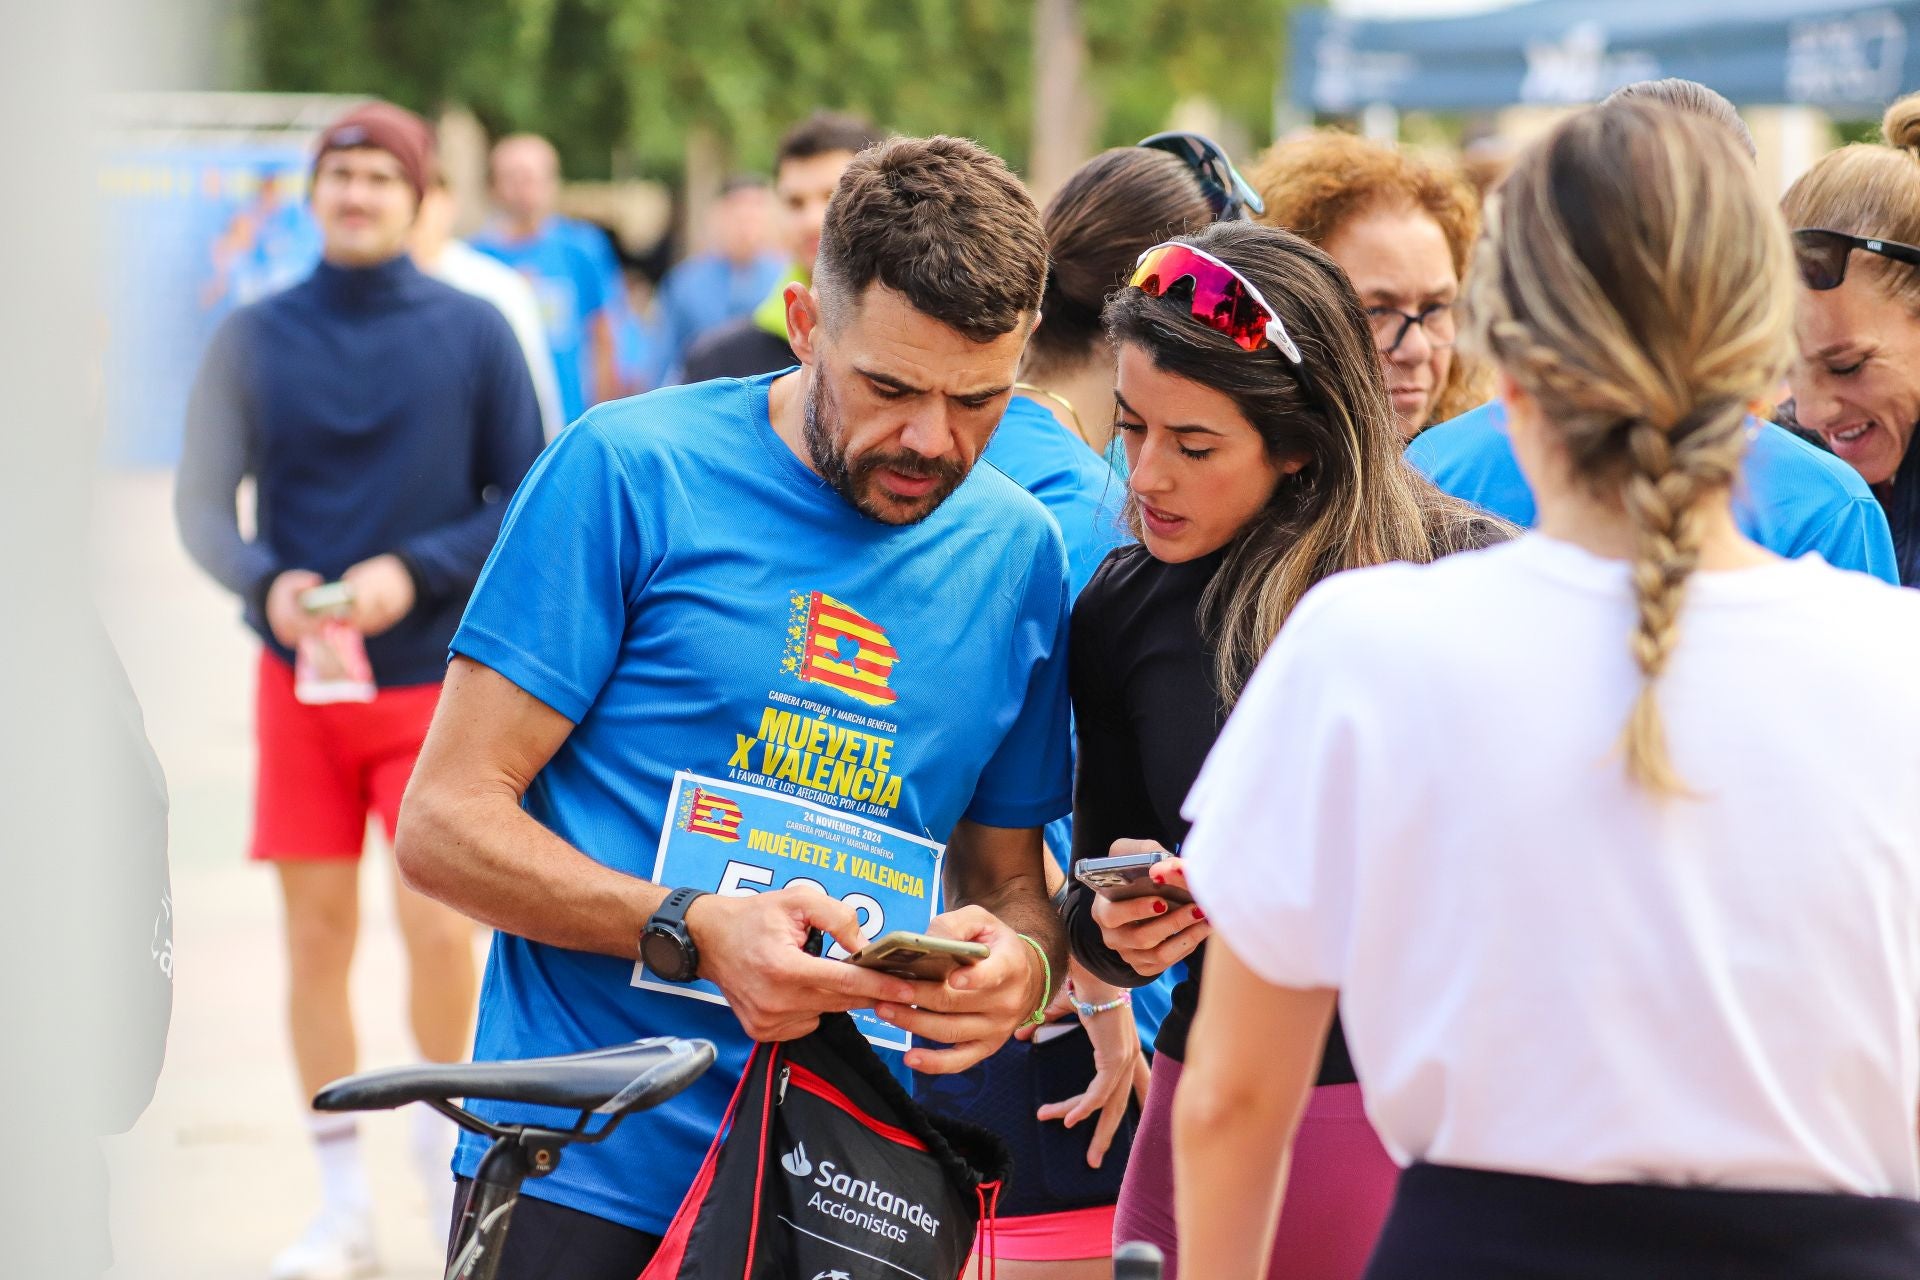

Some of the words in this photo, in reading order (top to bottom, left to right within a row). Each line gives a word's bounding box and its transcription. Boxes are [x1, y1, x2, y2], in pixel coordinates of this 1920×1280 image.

[768, 690, 800, 706] CARRERA
[800, 700, 830, 716] POPULAR
[832, 708, 838, 717] Y
[836, 710, 866, 726] MARCHA
[866, 718, 898, 734] BENÉFICA
[757, 707, 894, 773] MUÉVETE
[727, 734, 757, 770] X
[762, 744, 902, 809] VALENCIA
[729, 769, 736, 778] A
[736, 770, 765, 786] FAVOR
[766, 778, 778, 789] DE
[778, 781, 795, 794] LOS
[796, 786, 839, 806] AFECTADOS
[840, 798, 857, 810] POR
[856, 802, 867, 813] LA
[866, 804, 889, 818] DANA
[786, 820, 814, 835] CARRERA
[814, 828, 840, 844] POPULAR
[841, 835, 846, 844] Y
[846, 837, 870, 853] MARCHA
[870, 844, 895, 861] BENÉFICA
[804, 812, 814, 822] 24
[815, 814, 861, 837] NOVIEMBRE
[862, 828, 882, 844] 2024
[747, 828, 833, 869] MUÉVETE
[834, 851, 848, 874] X
[851, 856, 925, 899] VALENCIA
[807, 1191, 908, 1244] Accionistas
[813, 1161, 940, 1237] Santander
